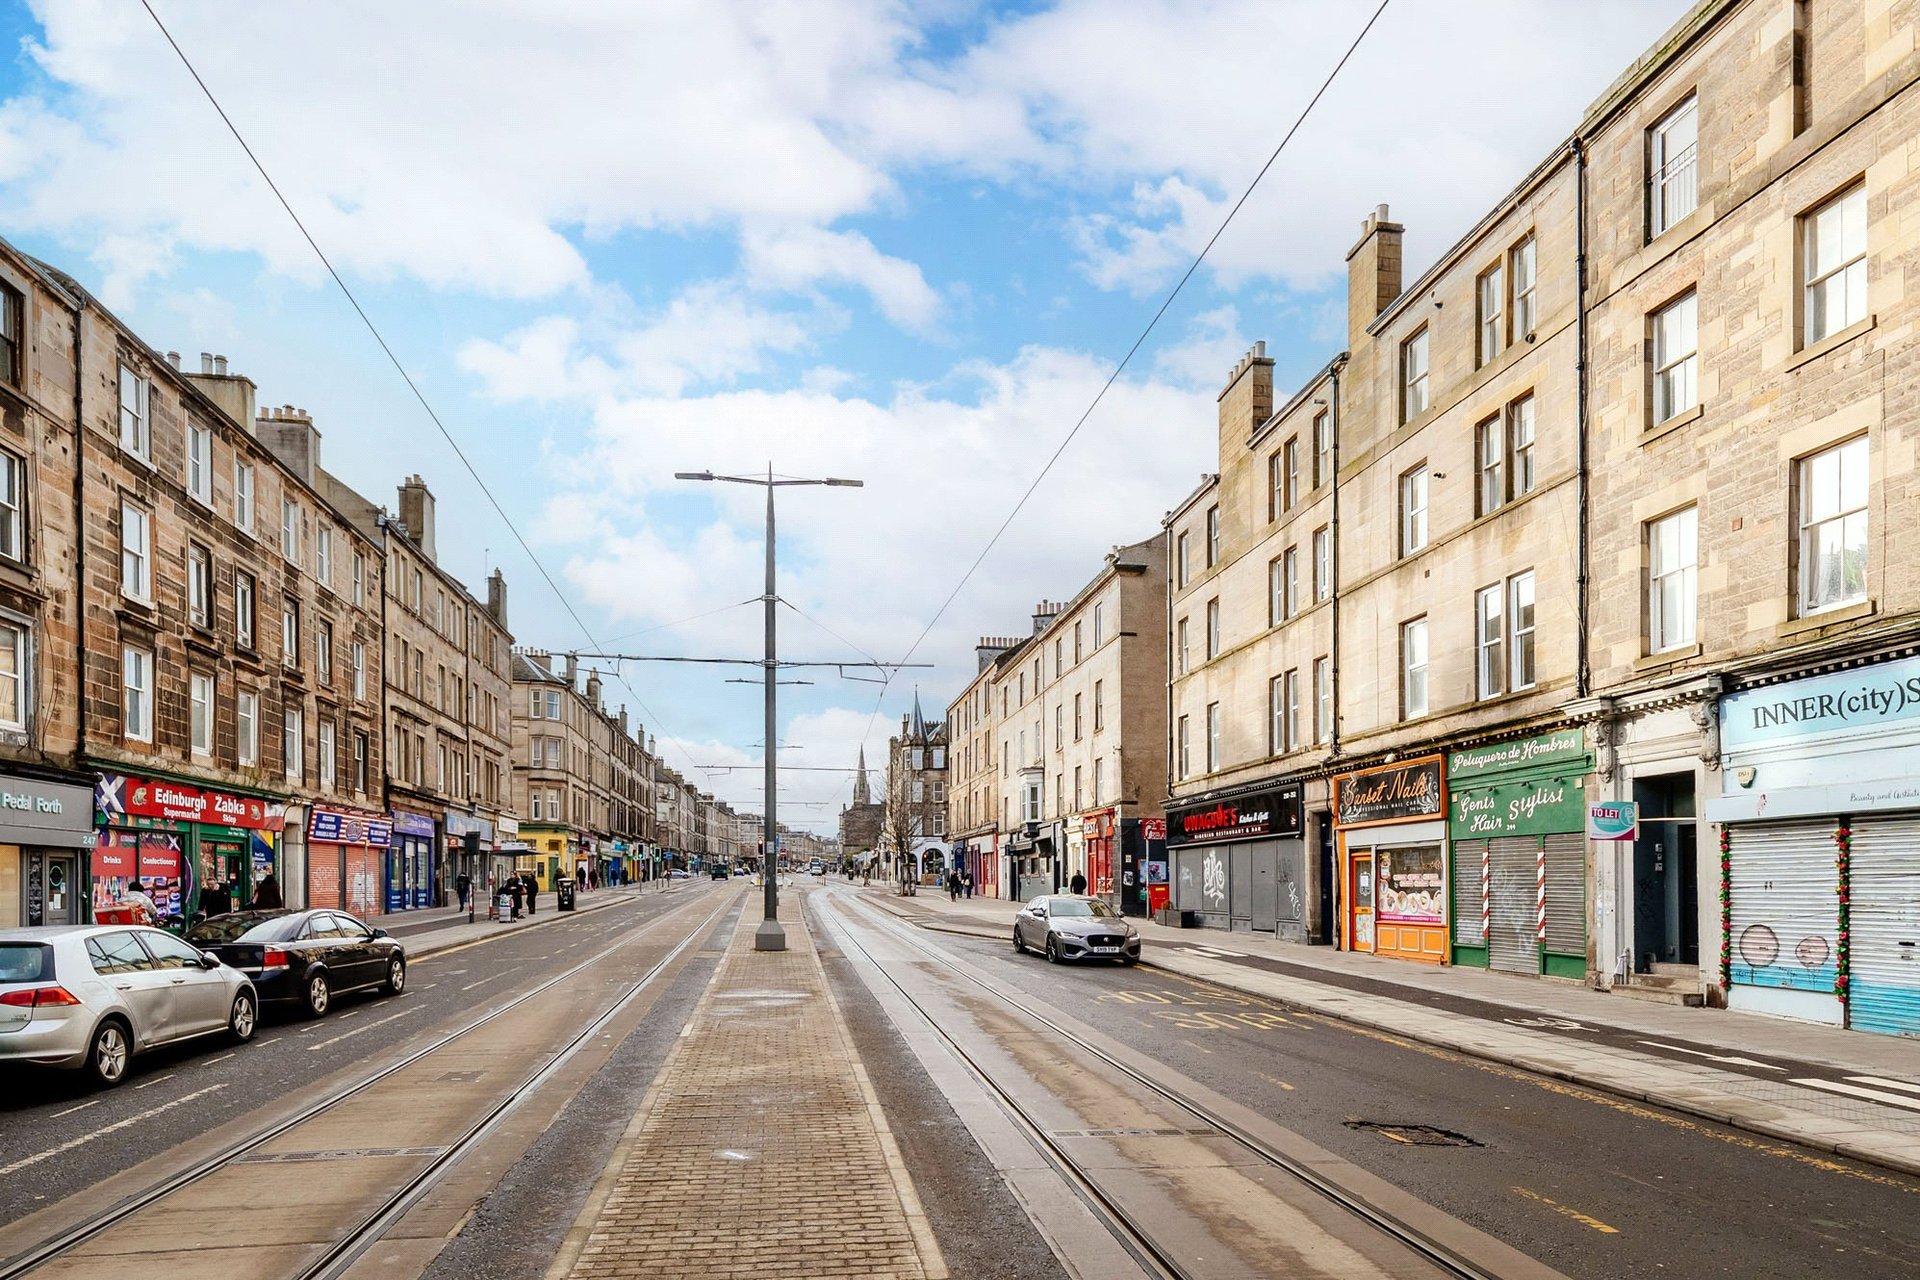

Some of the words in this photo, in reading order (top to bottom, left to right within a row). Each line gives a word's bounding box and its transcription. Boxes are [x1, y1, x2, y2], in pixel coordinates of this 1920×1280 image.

[1452, 750, 1508, 773] Peluquero
[1508, 745, 1521, 759] de
[1521, 736, 1577, 761] Hombres
[1344, 778, 1389, 807] Sunset
[1387, 769, 1428, 801] Nails
[2, 792, 32, 811] Pedal
[36, 797, 62, 814] Forth
[155, 787, 207, 812] Edinburgh
[1459, 793, 1495, 822] Gents
[1509, 787, 1564, 821] Stylist
[163, 806, 201, 820] Supermarket
[222, 813, 237, 825] Sklep
[1470, 813, 1503, 832] Hair
[1592, 807, 1604, 818] TO
[1605, 808, 1619, 819] LET
[82, 835, 96, 845] 247
[1216, 828, 1244, 837] RESTAURANT
[103, 855, 122, 865] Drinks
[142, 856, 177, 868] Confectionery
